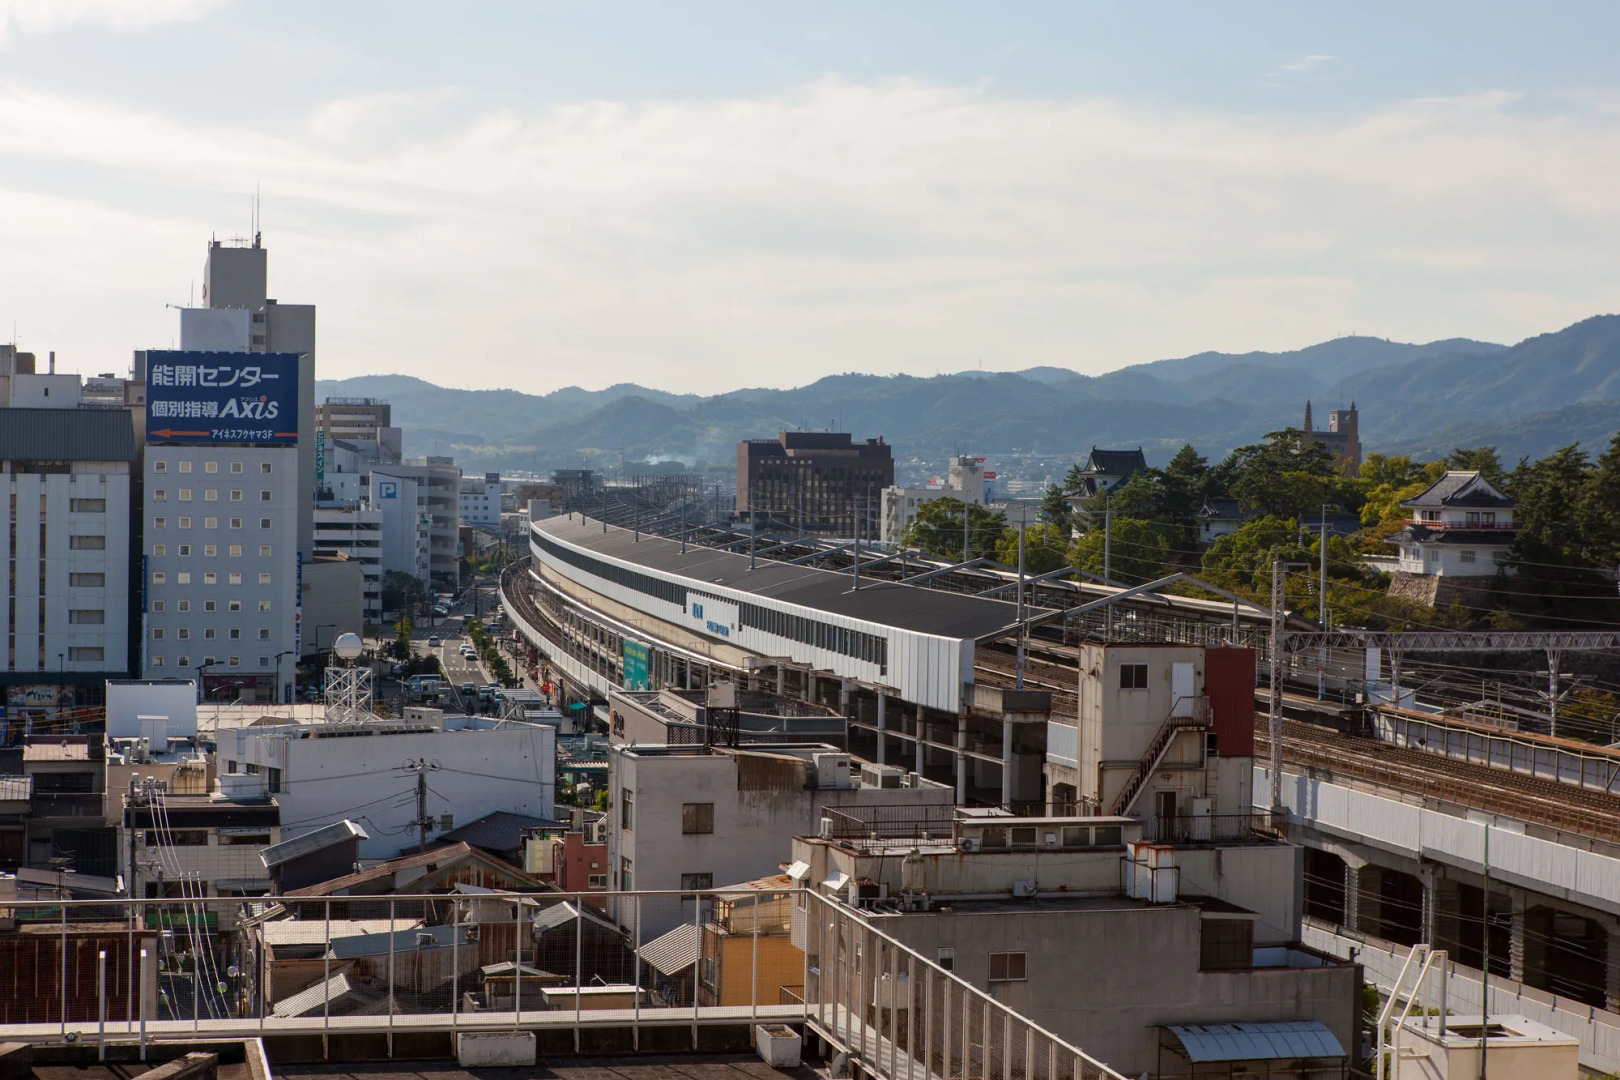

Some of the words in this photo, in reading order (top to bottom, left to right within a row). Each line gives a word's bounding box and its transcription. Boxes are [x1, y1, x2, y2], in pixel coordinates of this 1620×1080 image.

[152, 364, 279, 387] 能開センター
[151, 400, 218, 418] 個別指導
[212, 429, 273, 440] アイネスフクヤマ3F
[381, 483, 395, 498] P
